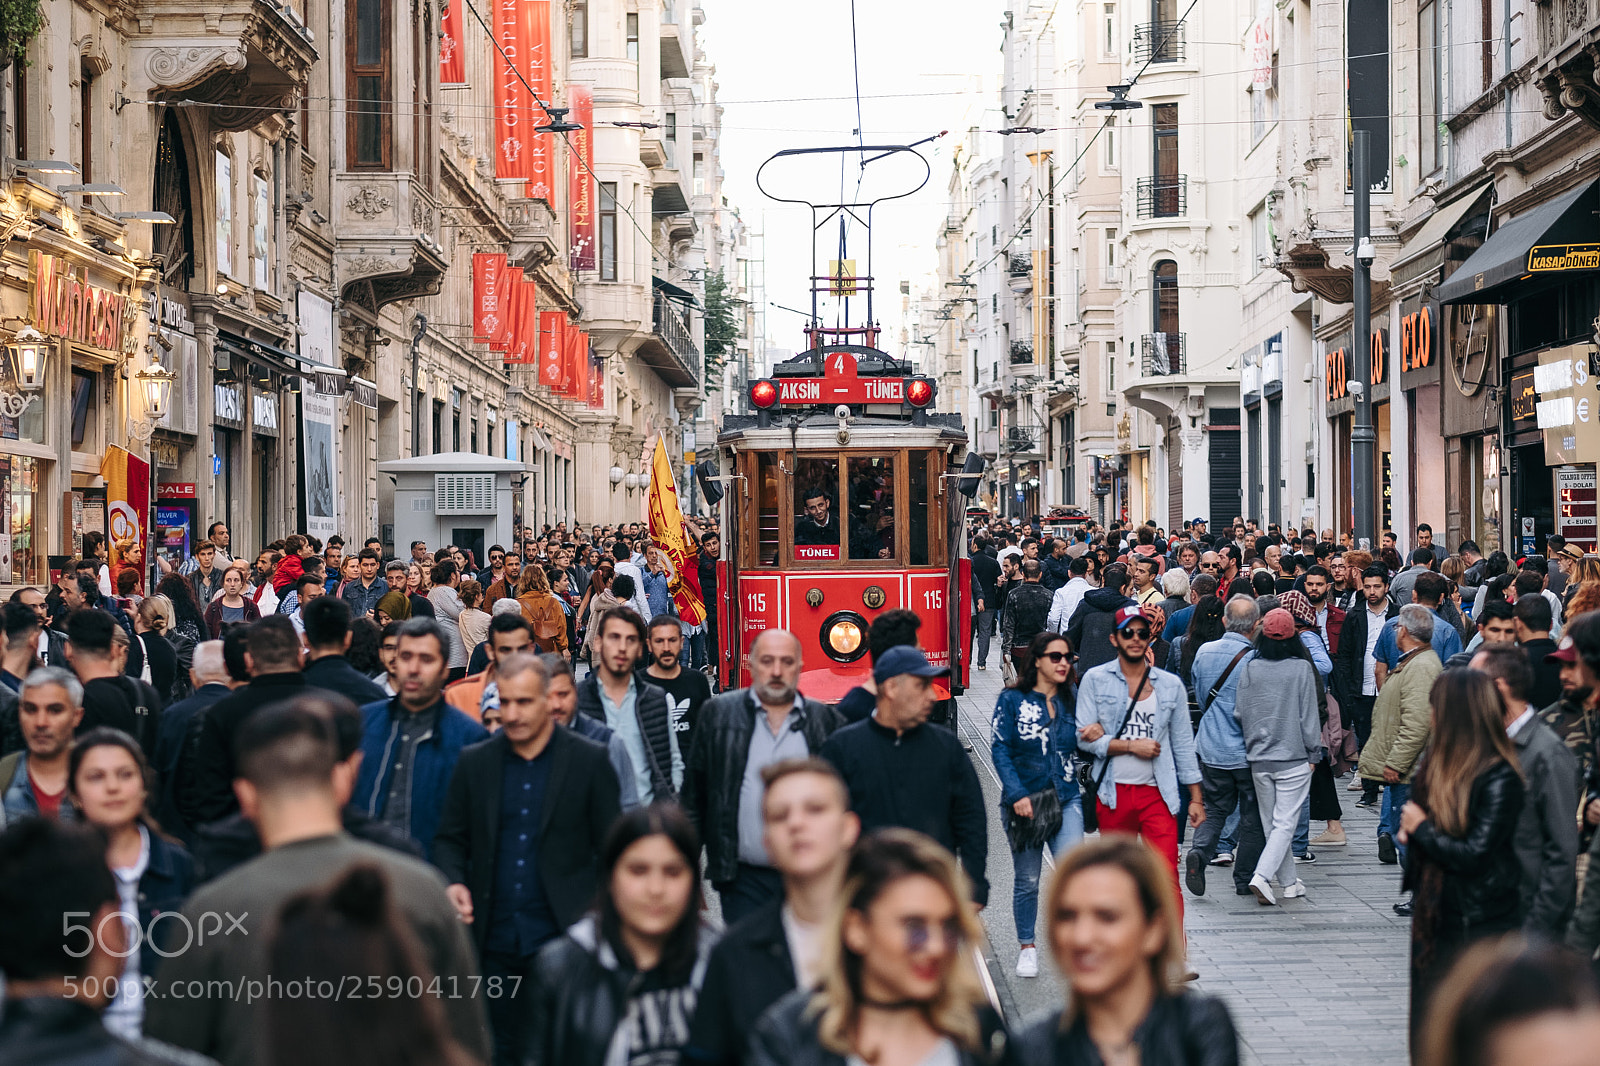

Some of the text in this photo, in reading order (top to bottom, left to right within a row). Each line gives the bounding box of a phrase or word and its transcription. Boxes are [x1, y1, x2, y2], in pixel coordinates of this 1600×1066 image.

[530, 42, 546, 174] GRANDPERA
[574, 129, 589, 226] Madame Tussauds
[485, 258, 495, 295] GIZIA
[1402, 306, 1431, 373] FLO
[834, 354, 844, 374] 4
[1370, 329, 1384, 385] LO
[322, 374, 338, 395] DESA
[779, 380, 820, 399] AKSİM
[864, 380, 904, 399] TÜNEL
[1326, 347, 1346, 402] FLO
[214, 384, 242, 422] DESA
[253, 395, 277, 429] DESA
[157, 486, 194, 494] SALE
[800, 548, 835, 557] TÜNEL
[748, 593, 766, 612] 115
[923, 590, 942, 610] 115
